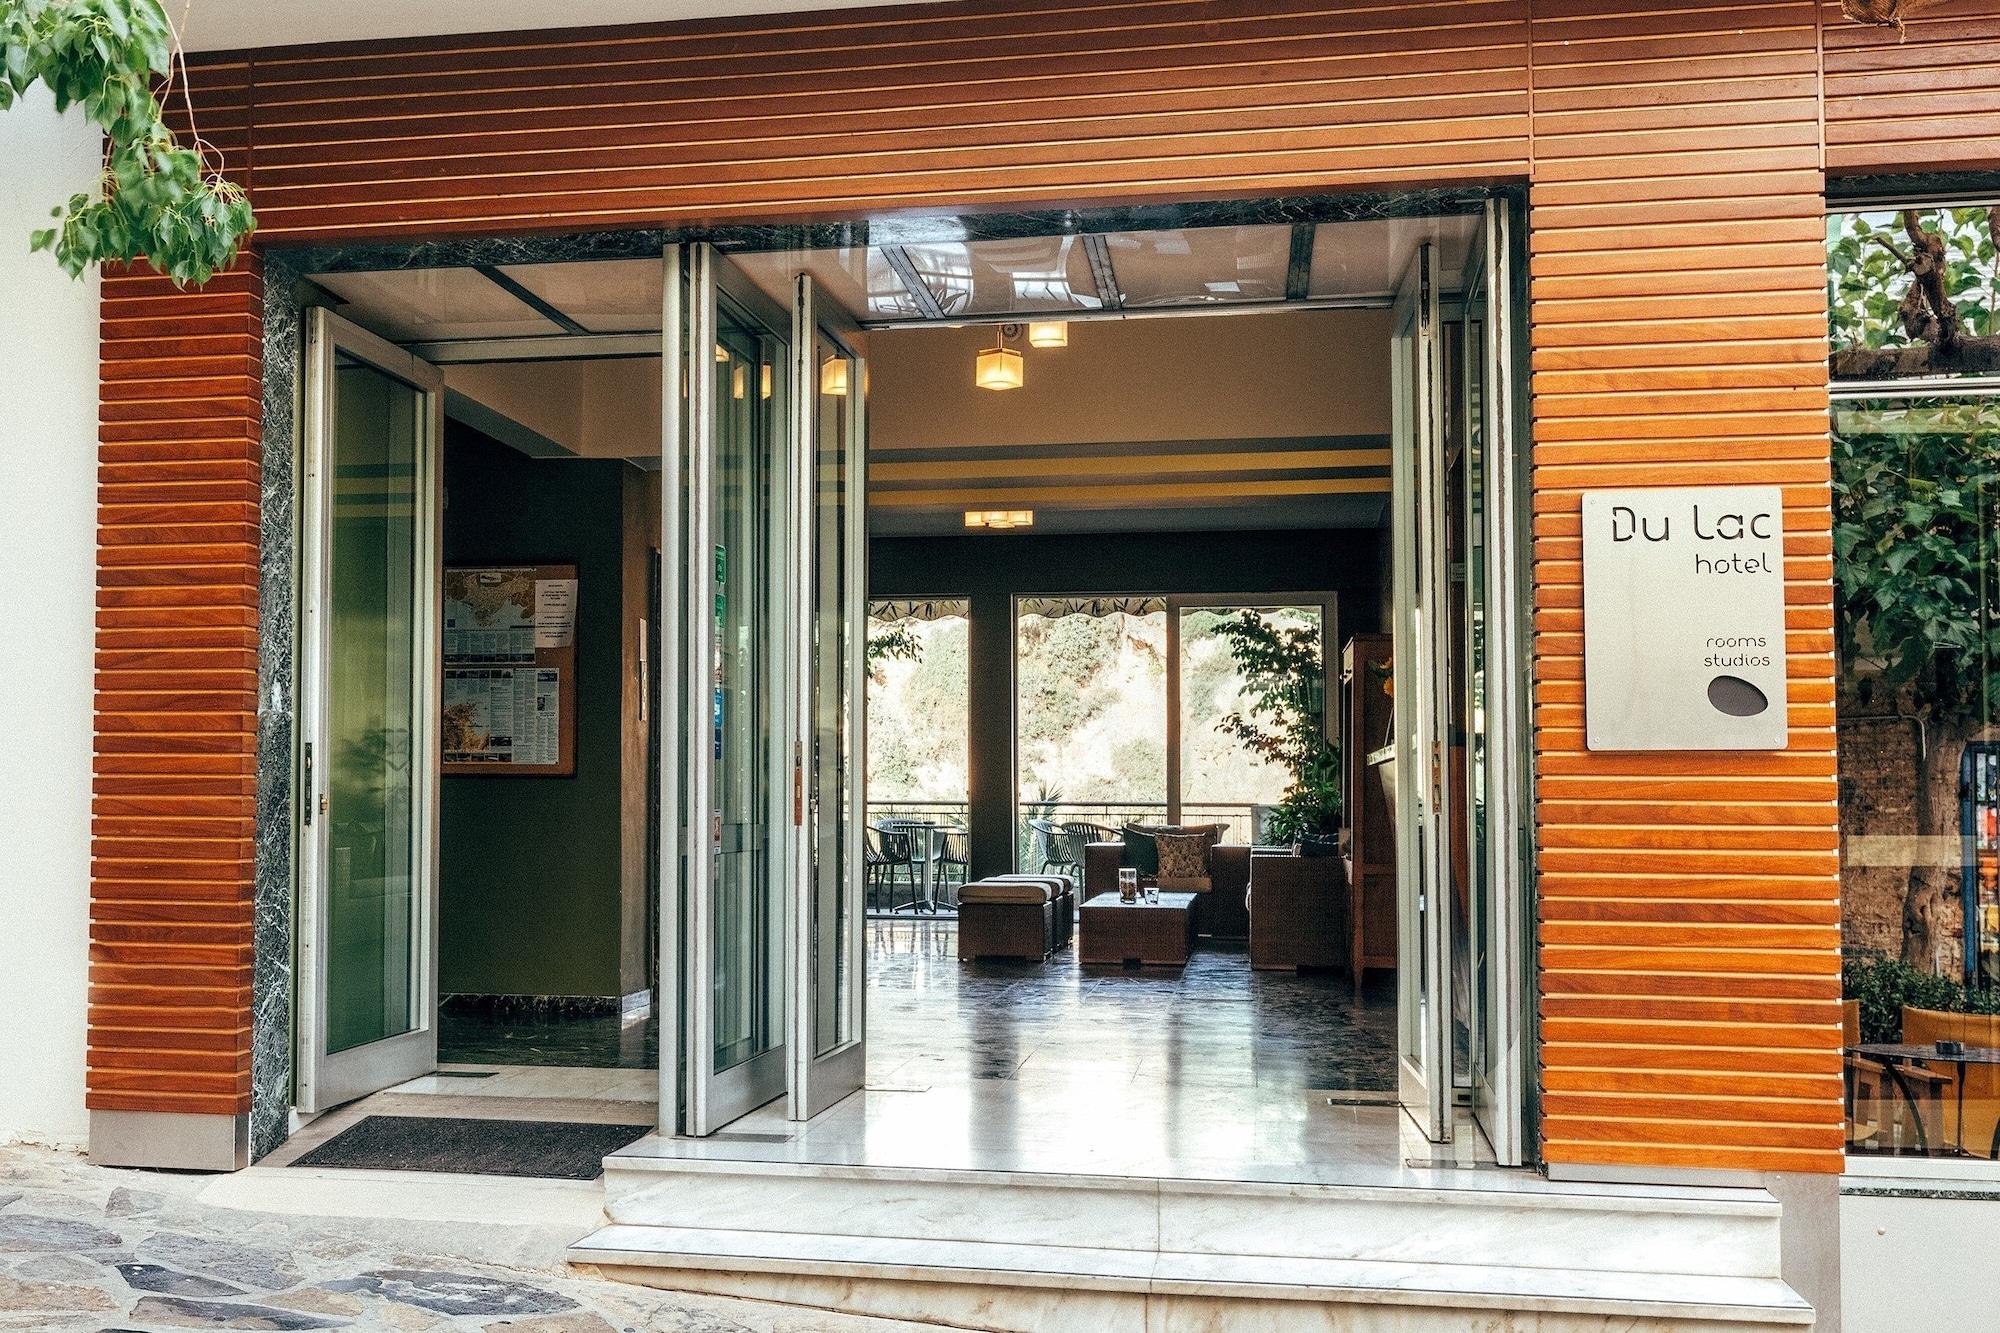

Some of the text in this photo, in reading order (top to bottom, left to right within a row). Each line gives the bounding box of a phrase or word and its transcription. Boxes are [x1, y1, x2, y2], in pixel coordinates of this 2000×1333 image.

[1612, 506, 1670, 542] Du
[1695, 552, 1772, 575] hotel
[1705, 635, 1767, 648] rooms
[1703, 653, 1771, 668] studios
